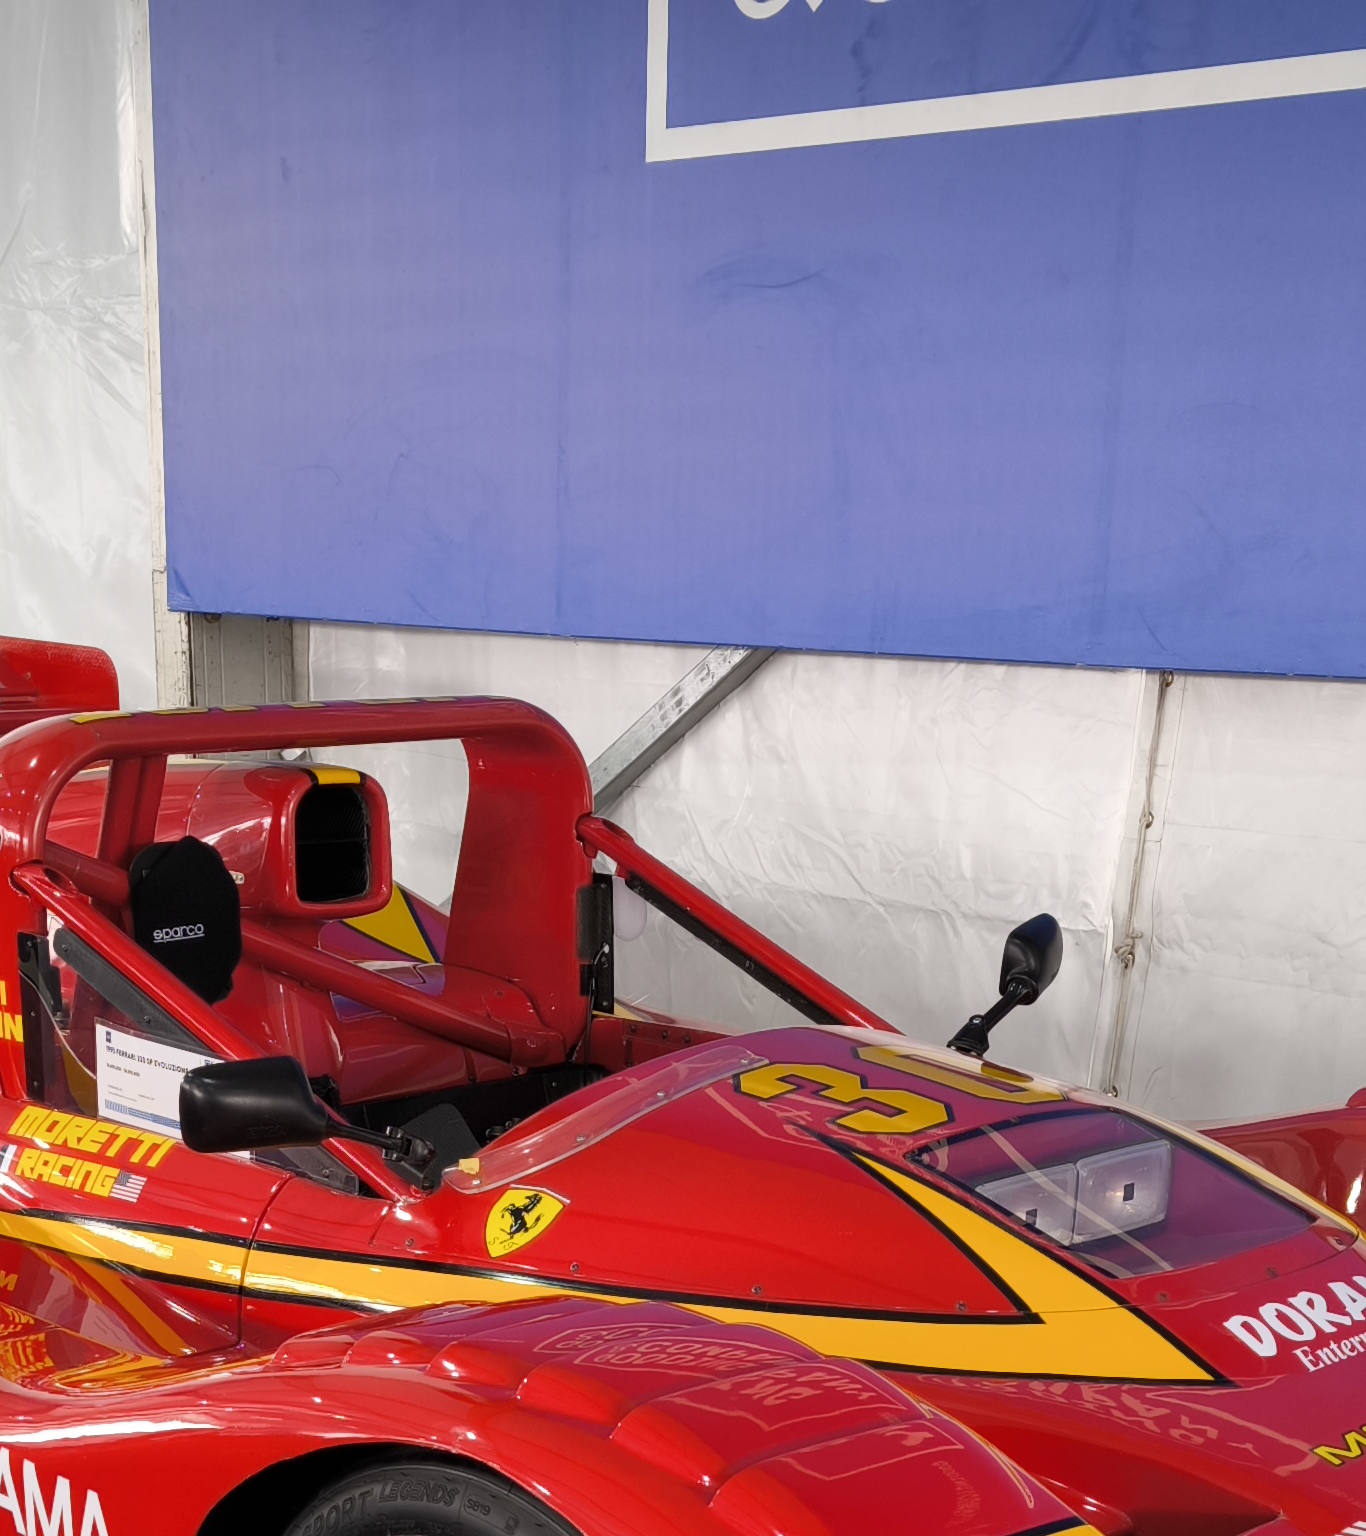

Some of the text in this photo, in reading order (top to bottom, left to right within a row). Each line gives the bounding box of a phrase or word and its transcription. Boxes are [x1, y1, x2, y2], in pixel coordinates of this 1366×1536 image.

[153, 922, 205, 942] sparco
[733, 1044, 1069, 1136] 30
[7, 1105, 177, 1168] MORETTI
[14, 1147, 122, 1198] RACING
[378, 1480, 460, 1507] LEGENDS
